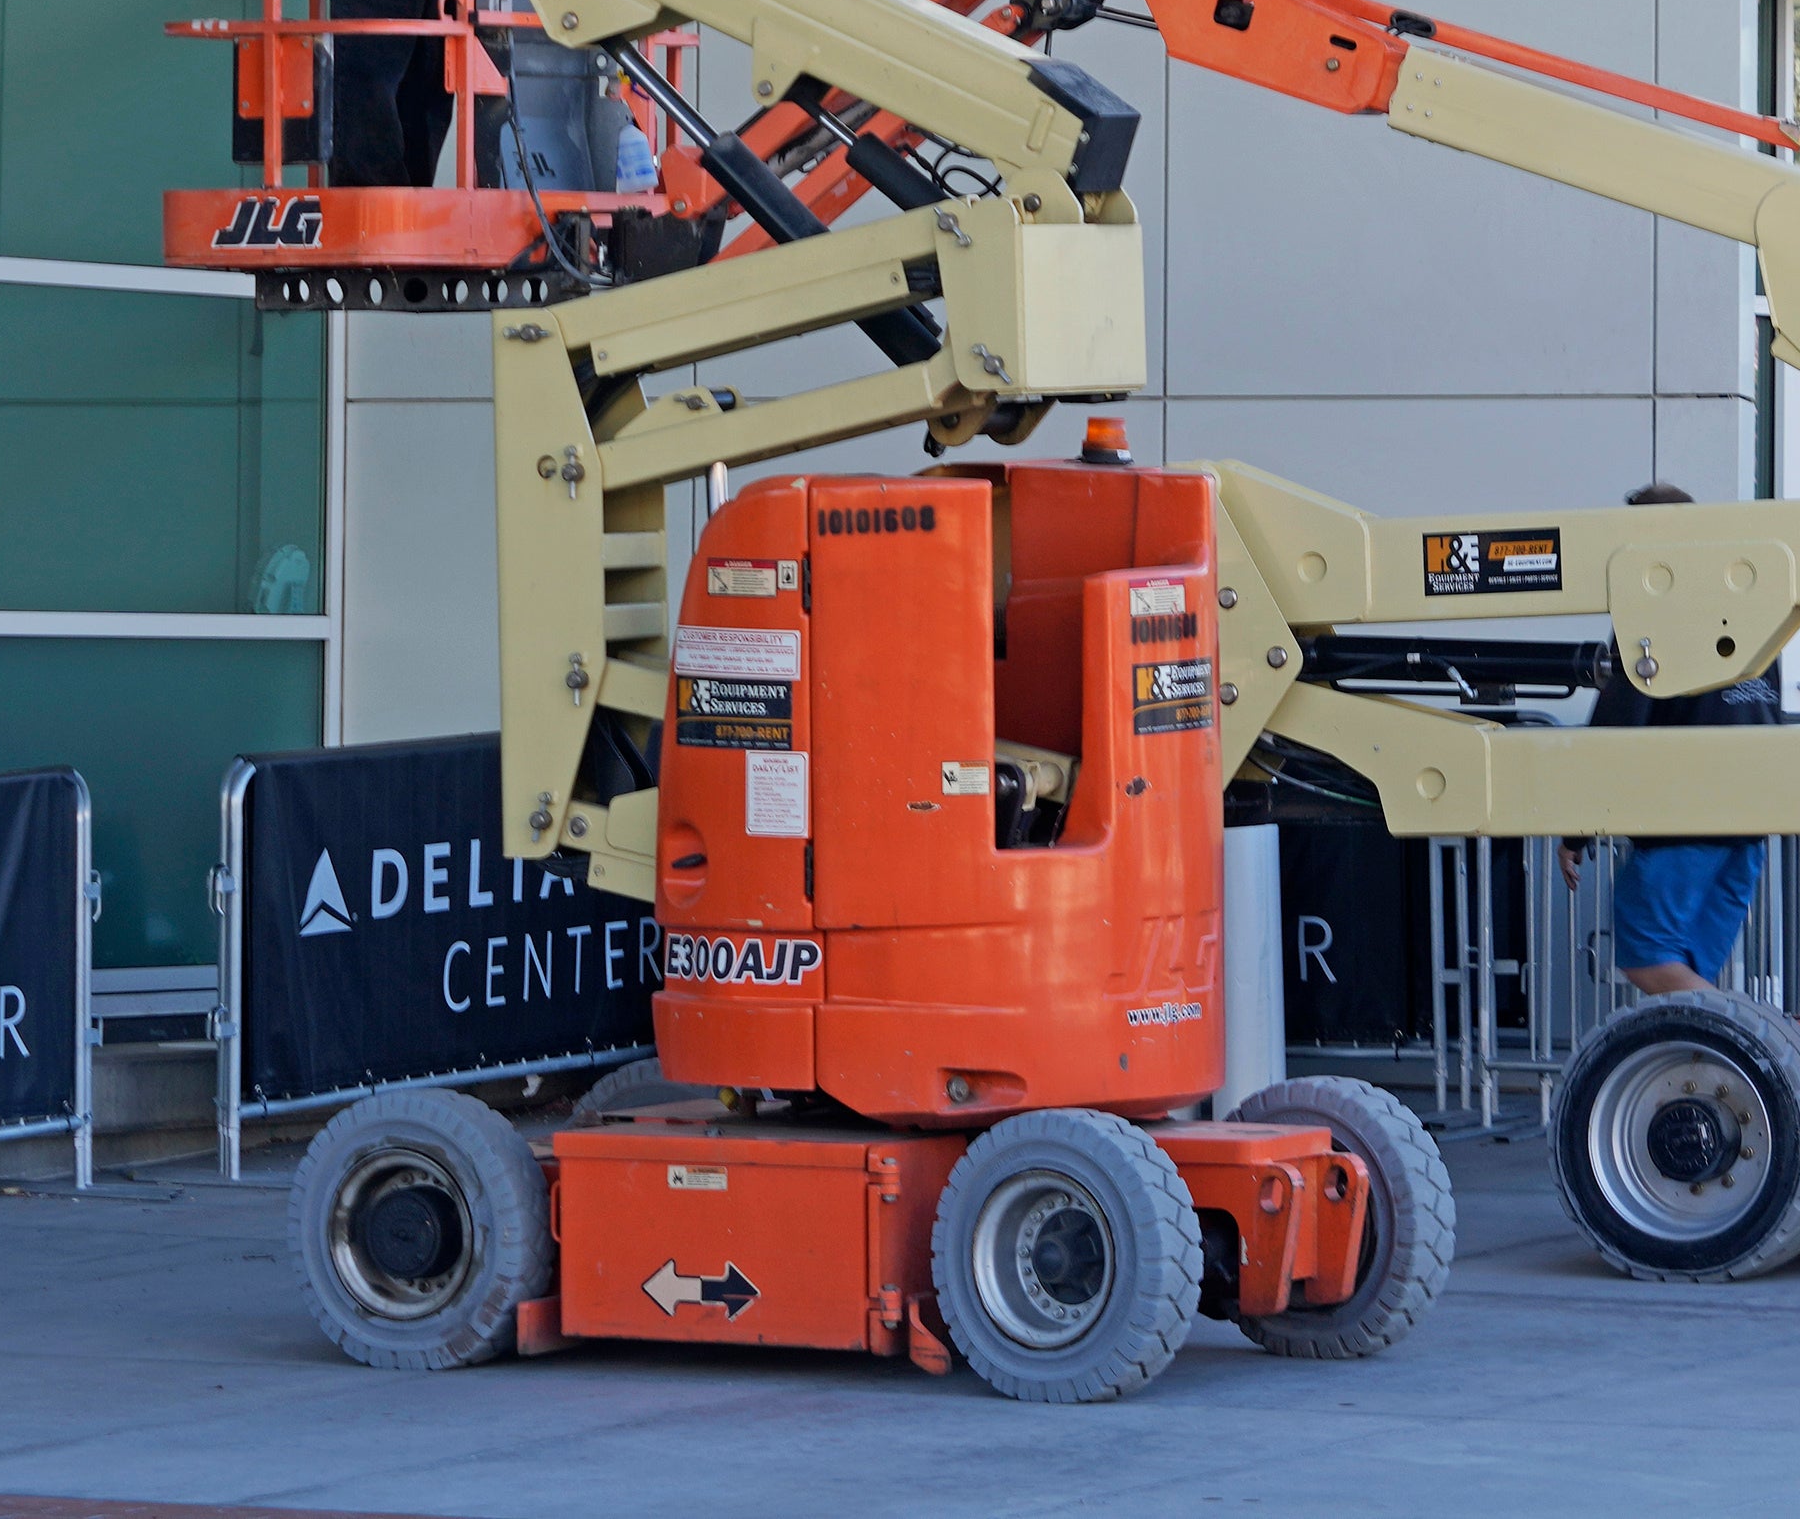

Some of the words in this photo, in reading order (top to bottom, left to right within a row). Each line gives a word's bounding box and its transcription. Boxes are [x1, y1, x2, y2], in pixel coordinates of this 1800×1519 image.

[210, 195, 323, 250] JLG
[818, 505, 936, 536] 10101608
[1427, 534, 1480, 573] H&E
[1428, 572, 1480, 584] EQUIPMENT
[1432, 581, 1475, 593] SERVICES
[710, 681, 788, 700] EQUIPMENT
[710, 697, 767, 716] SERVICES
[442, 915, 664, 1013] CENTER
[665, 934, 822, 986] E300AJP
[1126, 1002, 1202, 1028] www.jlg.com
